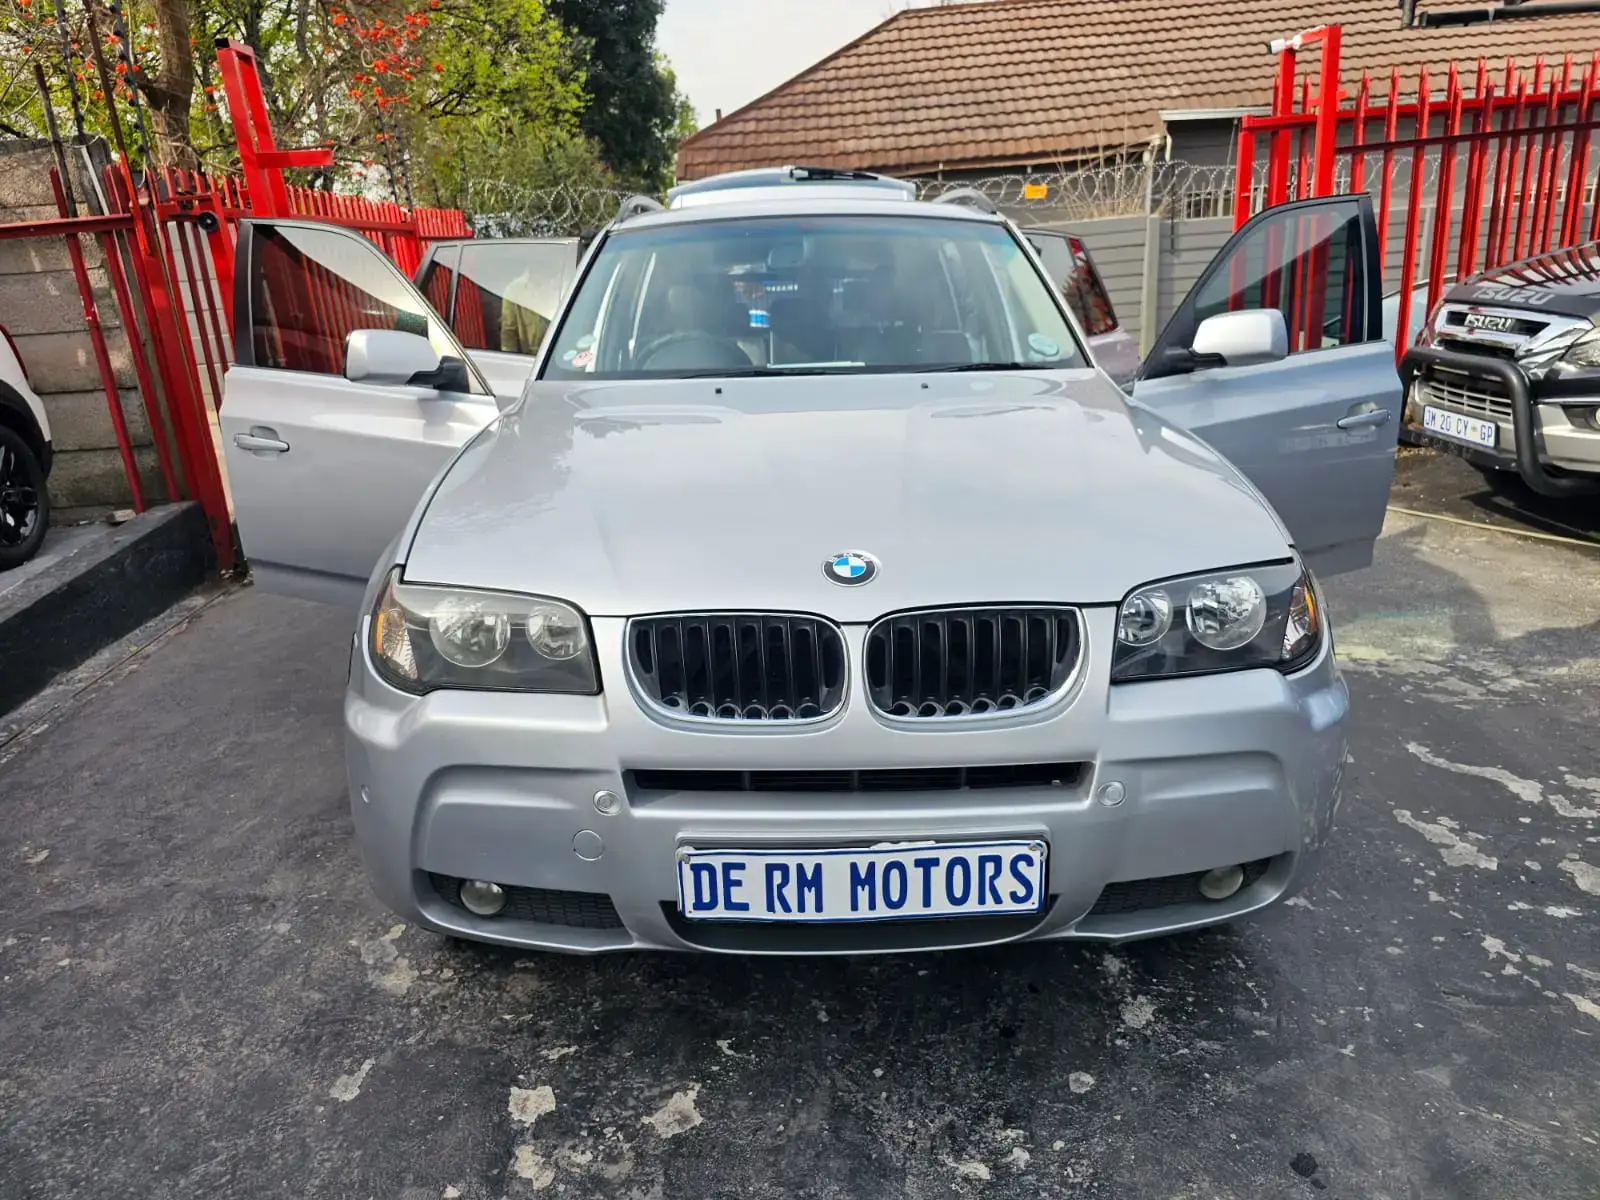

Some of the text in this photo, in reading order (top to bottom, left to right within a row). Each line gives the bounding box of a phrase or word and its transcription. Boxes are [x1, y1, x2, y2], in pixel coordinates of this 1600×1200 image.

[1472, 287, 1556, 305] ISUZU
[1464, 313, 1512, 332] ISUZU
[1425, 408, 1492, 441] JM 20 CY GP
[690, 853, 1035, 914] DE RM MOTORS
